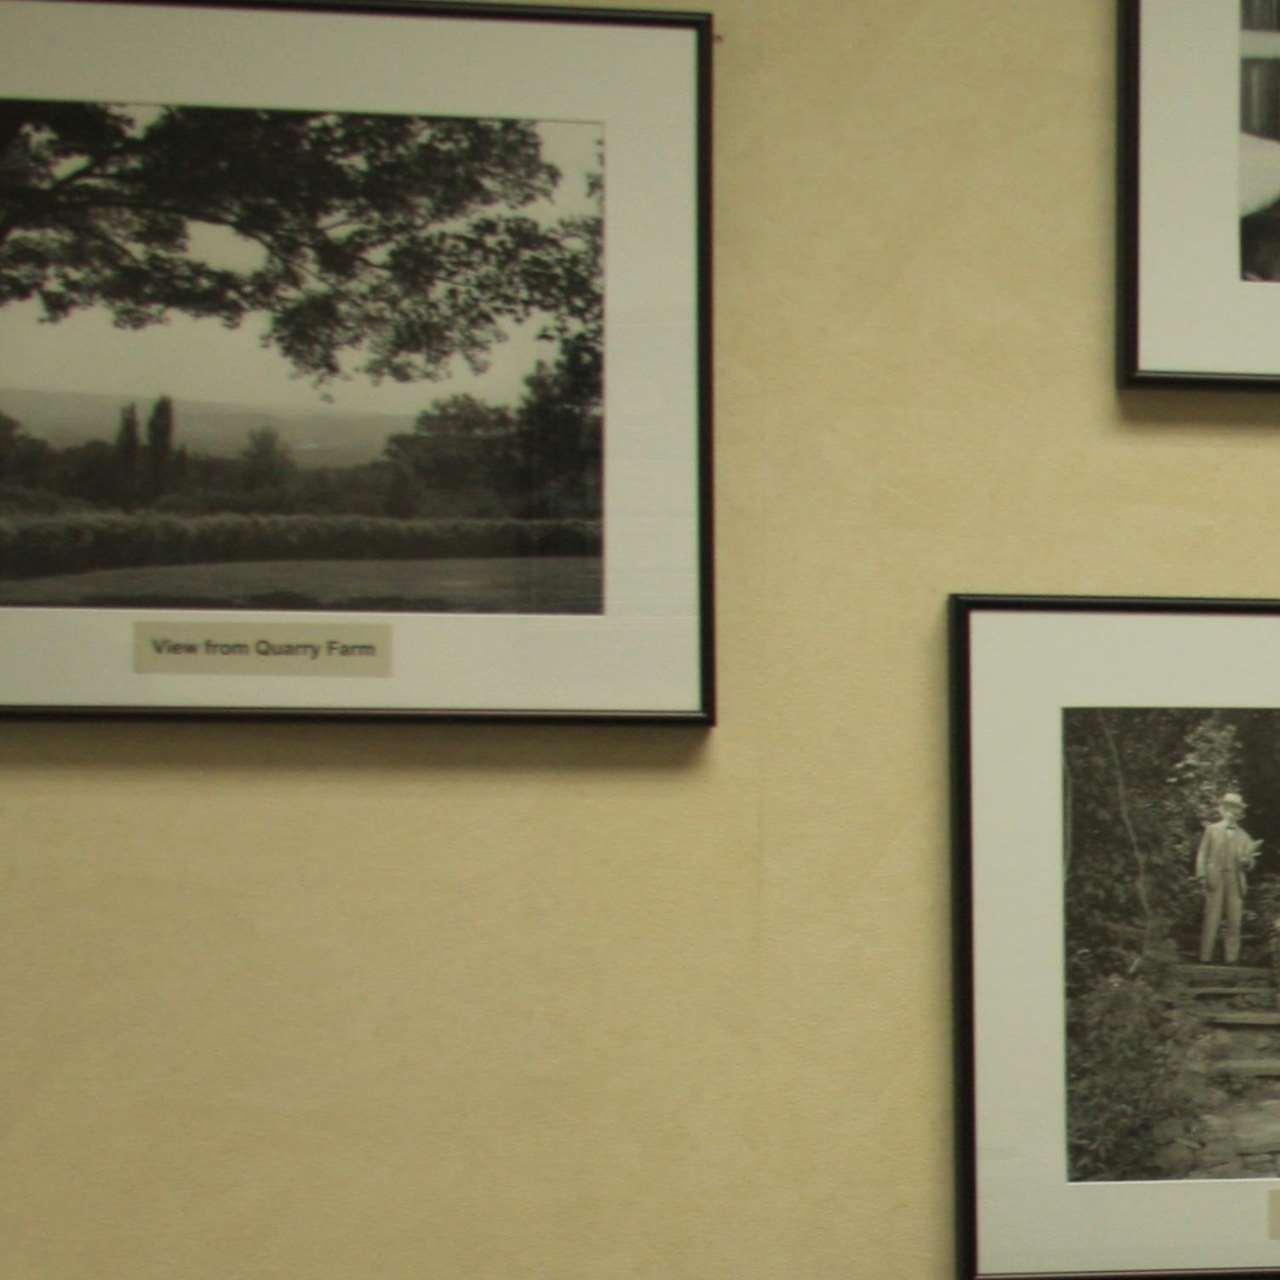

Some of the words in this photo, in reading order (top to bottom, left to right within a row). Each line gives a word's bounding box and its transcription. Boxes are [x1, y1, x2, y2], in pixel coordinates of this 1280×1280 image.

[152, 638, 198, 655] View
[204, 639, 249, 656] from
[255, 640, 321, 661] Quarry
[326, 641, 376, 657] Farm
